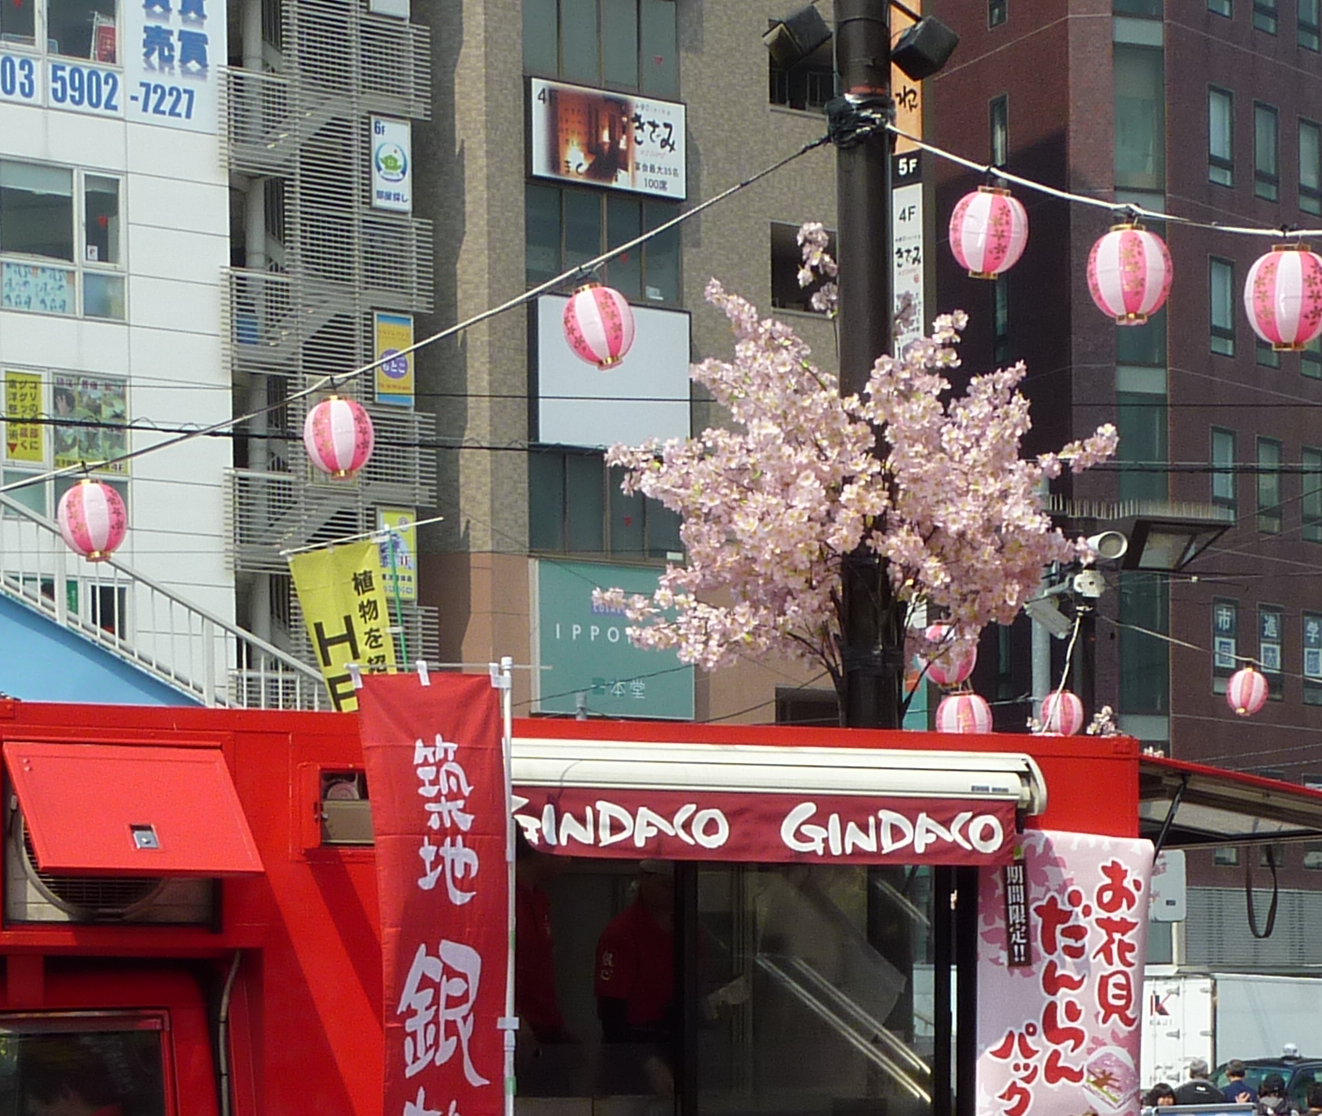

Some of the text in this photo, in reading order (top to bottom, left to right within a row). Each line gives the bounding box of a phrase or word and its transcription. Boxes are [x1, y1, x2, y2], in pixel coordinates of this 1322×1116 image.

[1, 56, 35, 98] 03
[51, 64, 118, 111] 5902
[898, 158, 917, 175] 5F
[898, 206, 916, 222] 4F
[413, 734, 479, 906] 築地
[780, 803, 1003, 857] GINDACO
[1093, 860, 1142, 1028] お花見
[1033, 888, 1093, 1085] だんらん
